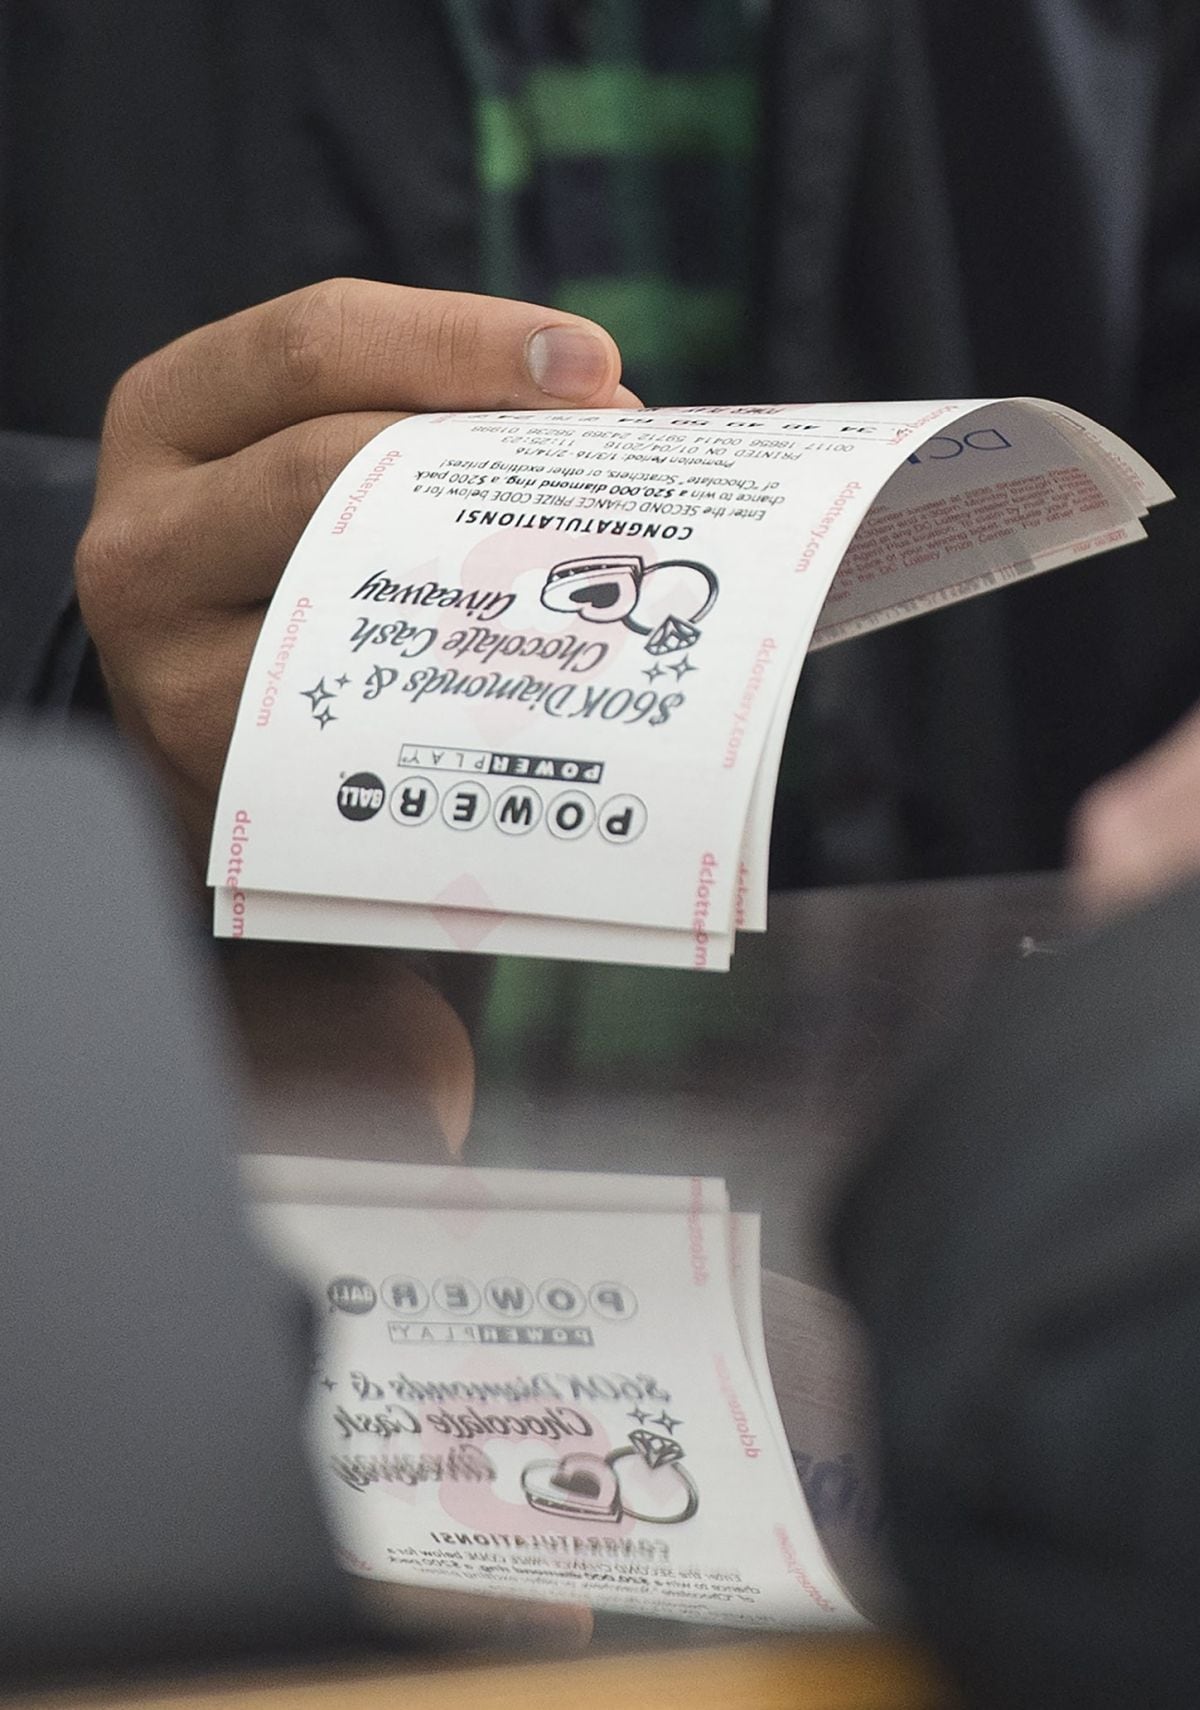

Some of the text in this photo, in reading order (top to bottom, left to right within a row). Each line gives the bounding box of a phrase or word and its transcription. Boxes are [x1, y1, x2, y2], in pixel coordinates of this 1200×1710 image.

[516, 447, 568, 458] 2/14/16
[603, 441, 699, 455] 01/04/2016
[705, 447, 727, 456] ON
[735, 449, 802, 460] PRINTED
[577, 450, 618, 461] 1/3/16
[623, 453, 667, 464] Period:
[439, 459, 490, 470] prizes!
[490, 460, 545, 475] exciting
[669, 457, 735, 469] Promotion
[546, 466, 584, 478] other
[586, 469, 602, 478] or
[606, 470, 678, 486] Scratchers,
[331, 449, 401, 536] dclottery.com
[413, 470, 785, 507] chance to win a $20,000 diamond ring, a $200 pack
[761, 481, 780, 492] of
[413, 484, 766, 522] Enter the SECOND CHANCE PRIZE CODE below for a
[454, 509, 694, 541] CONGRATULATIONS!
[794, 480, 862, 574] dclottery.com
[350, 570, 517, 622] Giveaway
[349, 617, 609, 673] Chocolate Cash
[256, 597, 314, 728] dclottery.com
[363, 664, 686, 727] $60K Diamonds &
